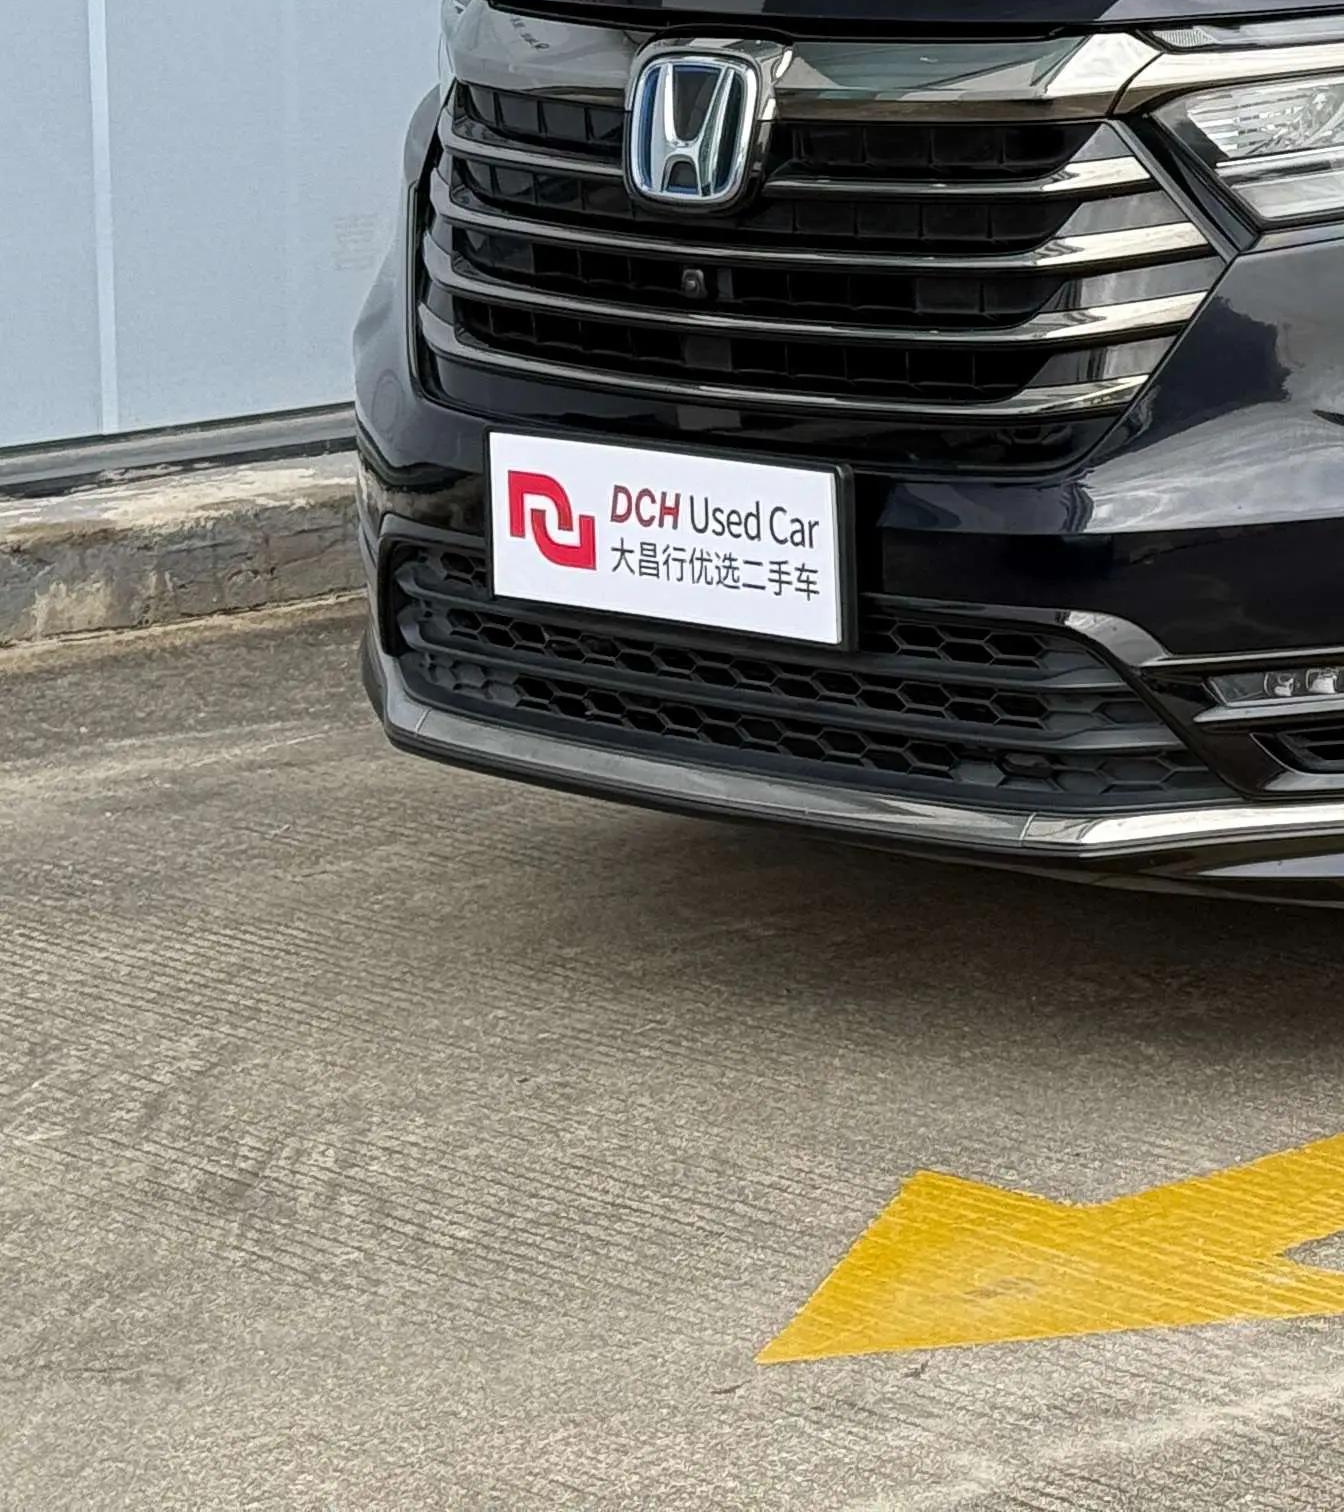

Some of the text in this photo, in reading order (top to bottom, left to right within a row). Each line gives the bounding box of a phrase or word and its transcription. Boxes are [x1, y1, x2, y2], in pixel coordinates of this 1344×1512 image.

[610, 484, 820, 550] DCH Used Car
[610, 536, 821, 601] 大昌行优选二手车
